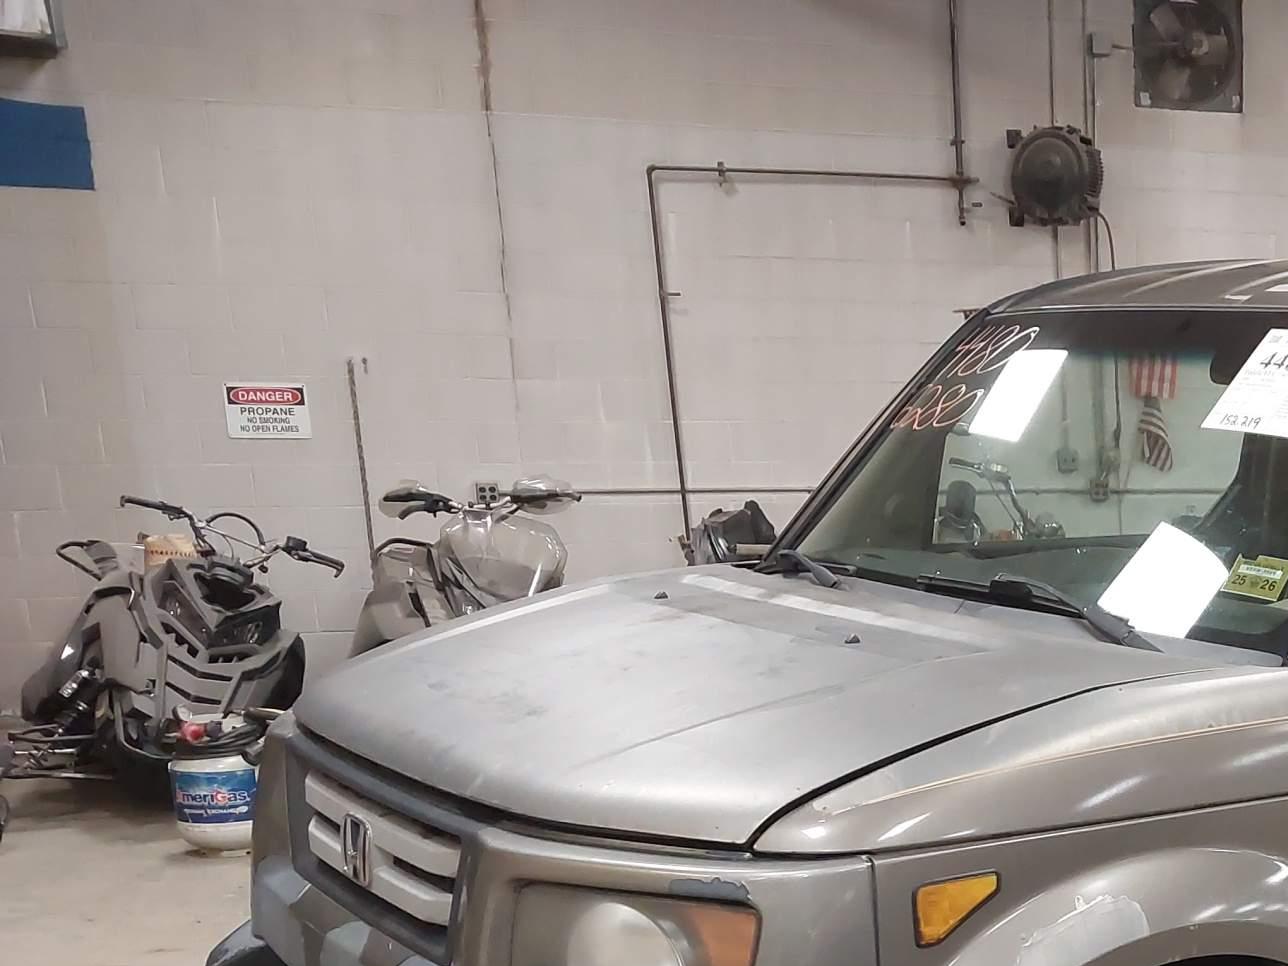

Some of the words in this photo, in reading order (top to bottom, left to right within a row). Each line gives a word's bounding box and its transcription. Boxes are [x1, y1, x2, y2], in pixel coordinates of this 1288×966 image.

[238, 391, 294, 402] DANGER
[240, 407, 296, 416] PROPANE
[240, 425, 250, 433] NO
[252, 425, 271, 433] OPEN
[272, 425, 300, 433] FLAMES
[1231, 574, 1247, 586] 25
[1260, 579, 1277, 591] 26
